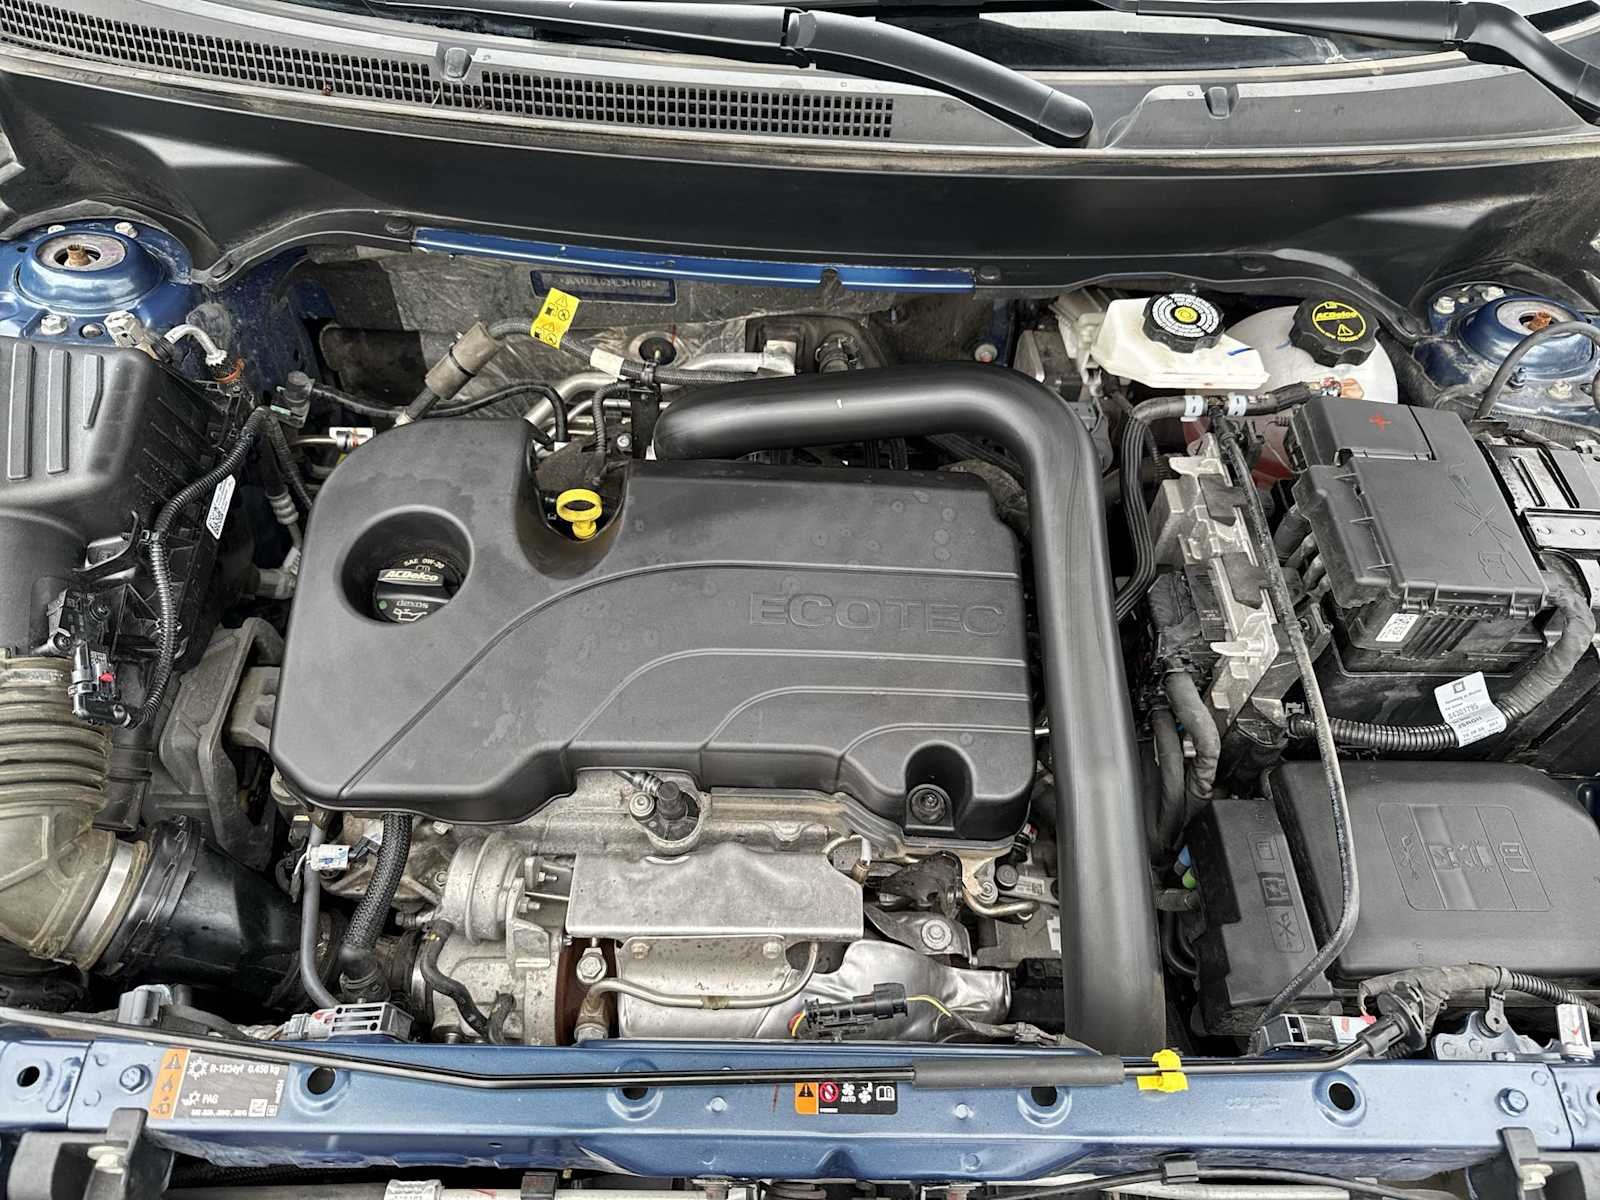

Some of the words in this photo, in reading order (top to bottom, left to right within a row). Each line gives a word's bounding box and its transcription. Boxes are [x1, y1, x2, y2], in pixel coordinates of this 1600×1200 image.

[385, 570, 439, 582] ACDelco
[396, 599, 429, 609] dexos
[750, 592, 1005, 637] ECOTEC
[201, 1094, 219, 1105] PAG
[840, 1095, 857, 1103] AUTO
